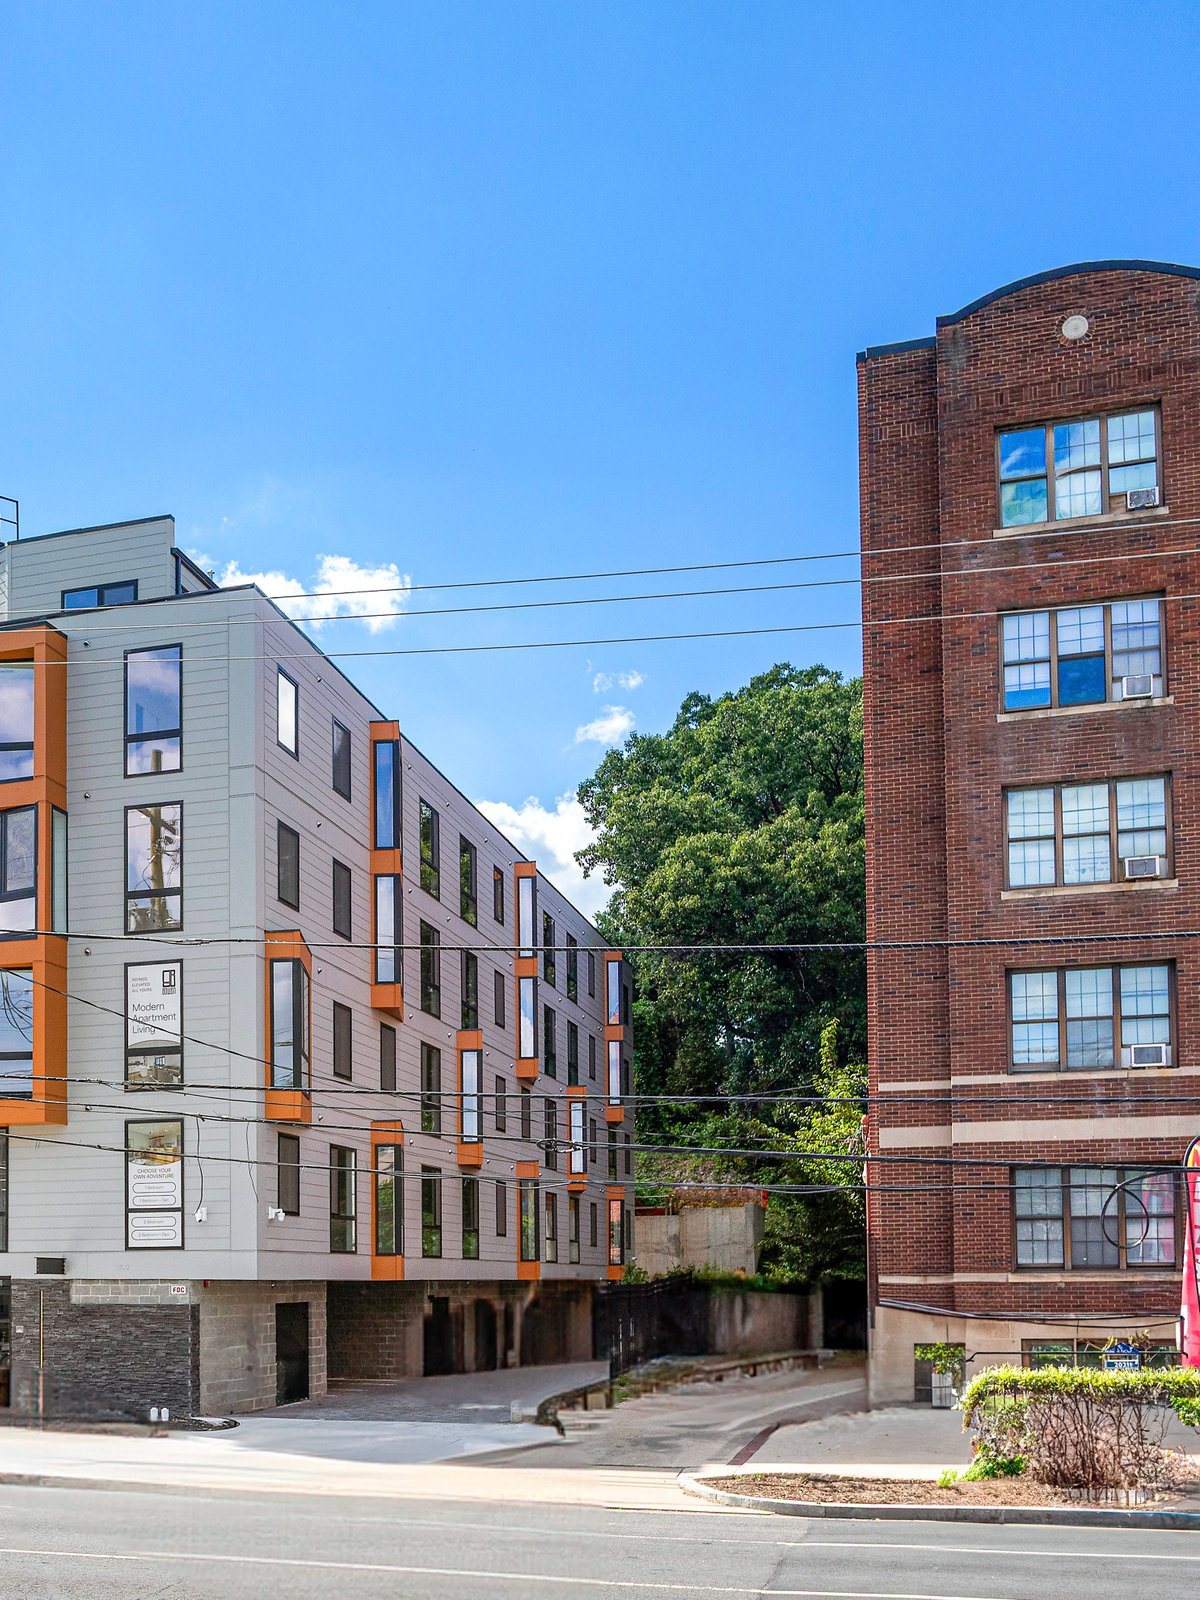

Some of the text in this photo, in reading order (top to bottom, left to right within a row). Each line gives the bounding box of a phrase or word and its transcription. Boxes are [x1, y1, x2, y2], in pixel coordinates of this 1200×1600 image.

[132, 1002, 165, 1012] Modern
[133, 1013, 176, 1023] Apartment
[132, 1025, 156, 1035] Living
